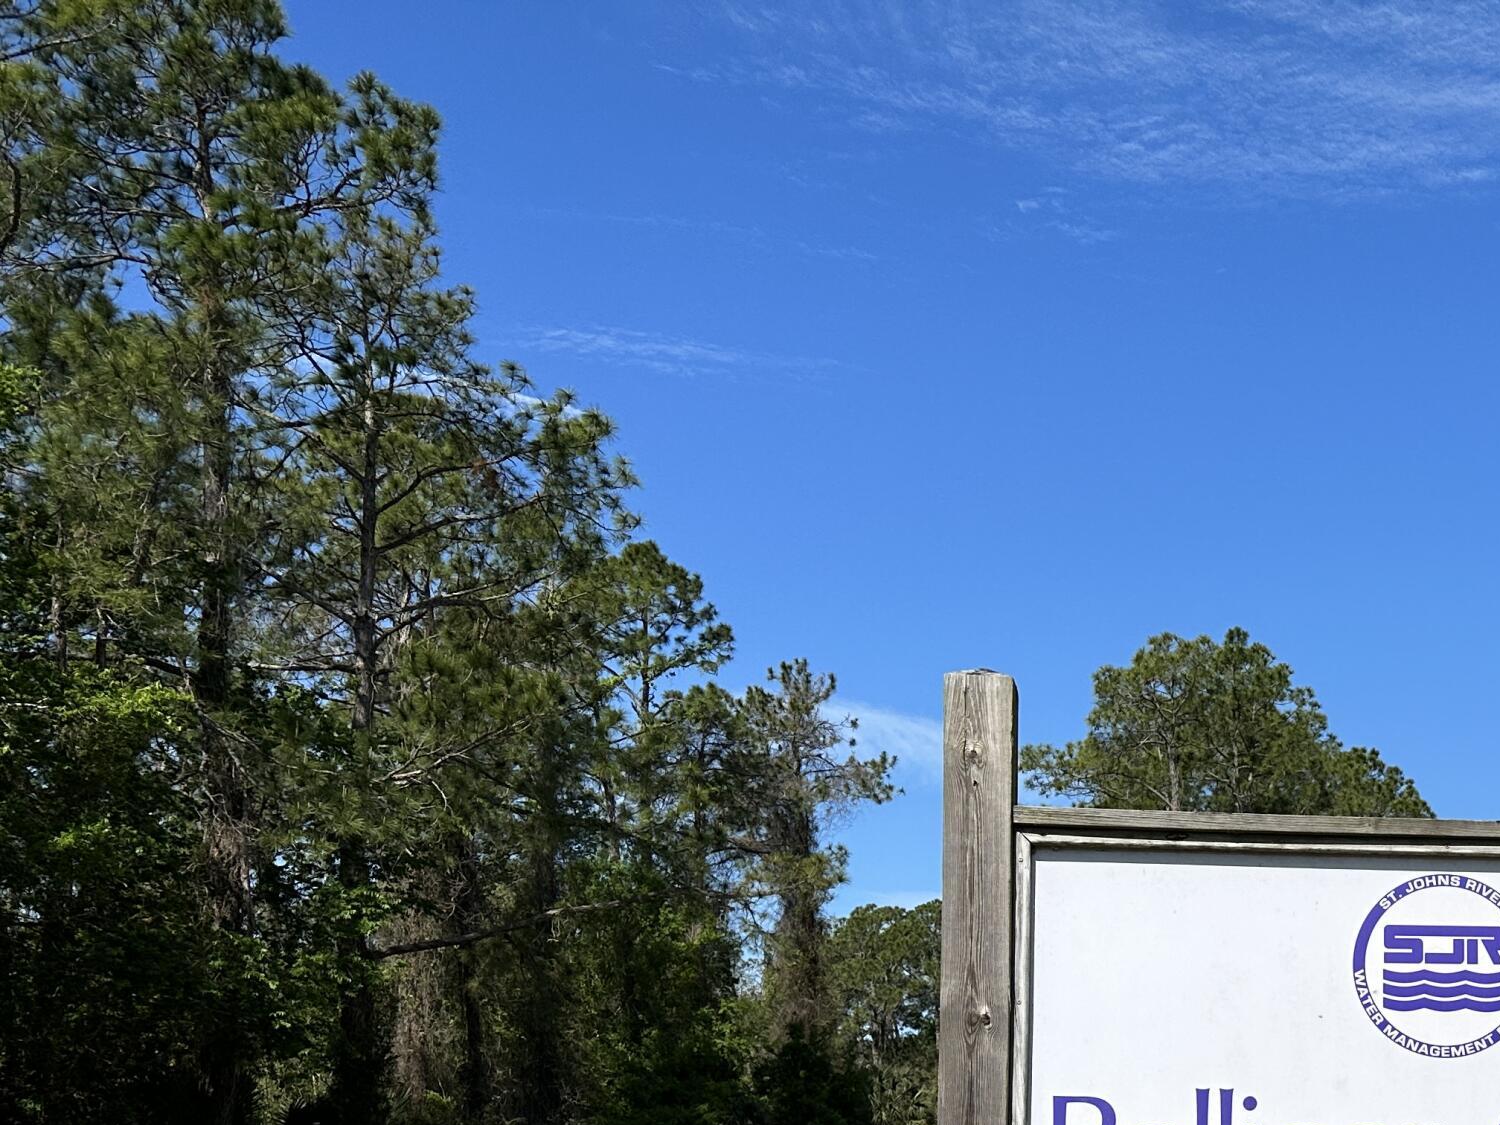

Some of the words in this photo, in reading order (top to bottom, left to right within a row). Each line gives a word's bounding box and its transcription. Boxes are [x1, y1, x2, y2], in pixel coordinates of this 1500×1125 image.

[1378, 891, 1403, 910] ST.
[1406, 875, 1461, 894] JOHNS
[1354, 969, 1385, 1026] WATER
[1383, 1024, 1494, 1058] MANAGEMENT
